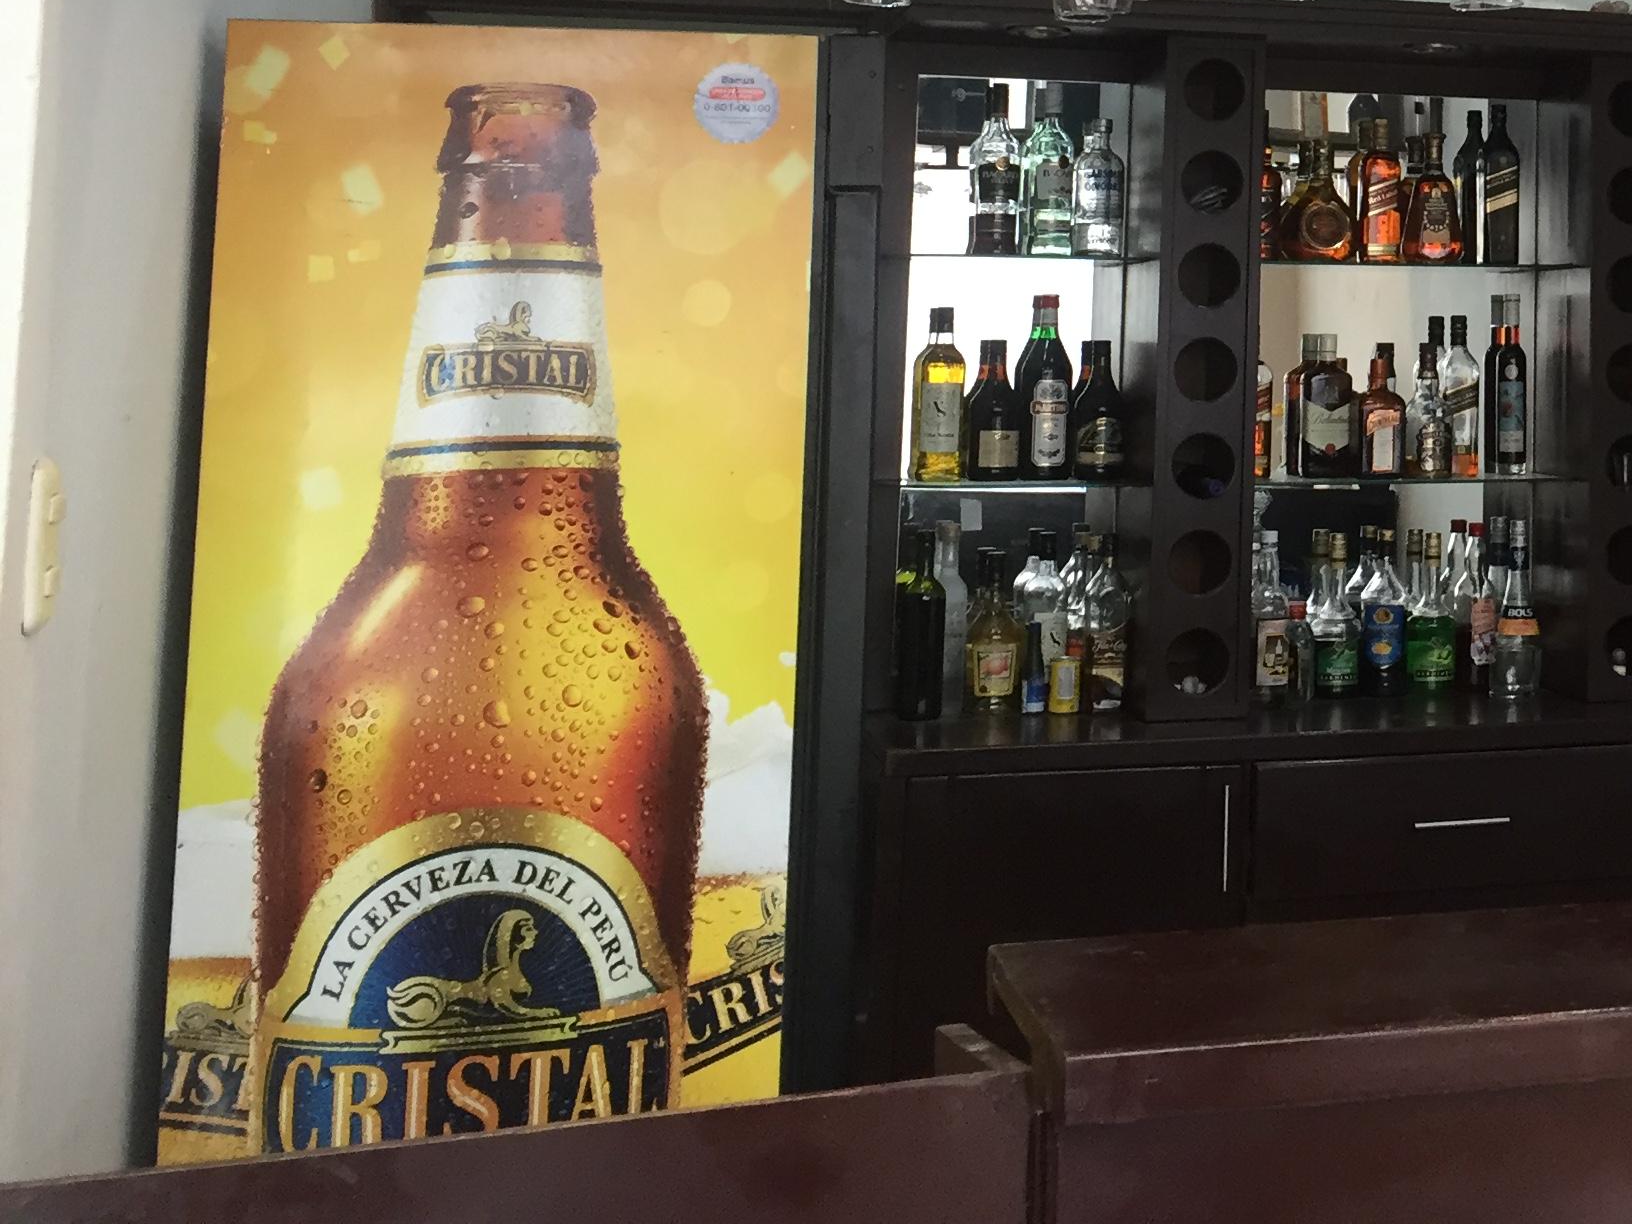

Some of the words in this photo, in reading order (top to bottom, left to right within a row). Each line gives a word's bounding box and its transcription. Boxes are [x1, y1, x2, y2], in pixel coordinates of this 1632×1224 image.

[431, 351, 584, 391] CRISTAL
[1507, 608, 1534, 618] BOLS
[320, 960, 355, 1002] LA
[347, 858, 499, 951] CERVEZA
[512, 859, 578, 905] DEL
[579, 896, 630, 983] PERÚ
[278, 1037, 659, 1152] CRISTAL
